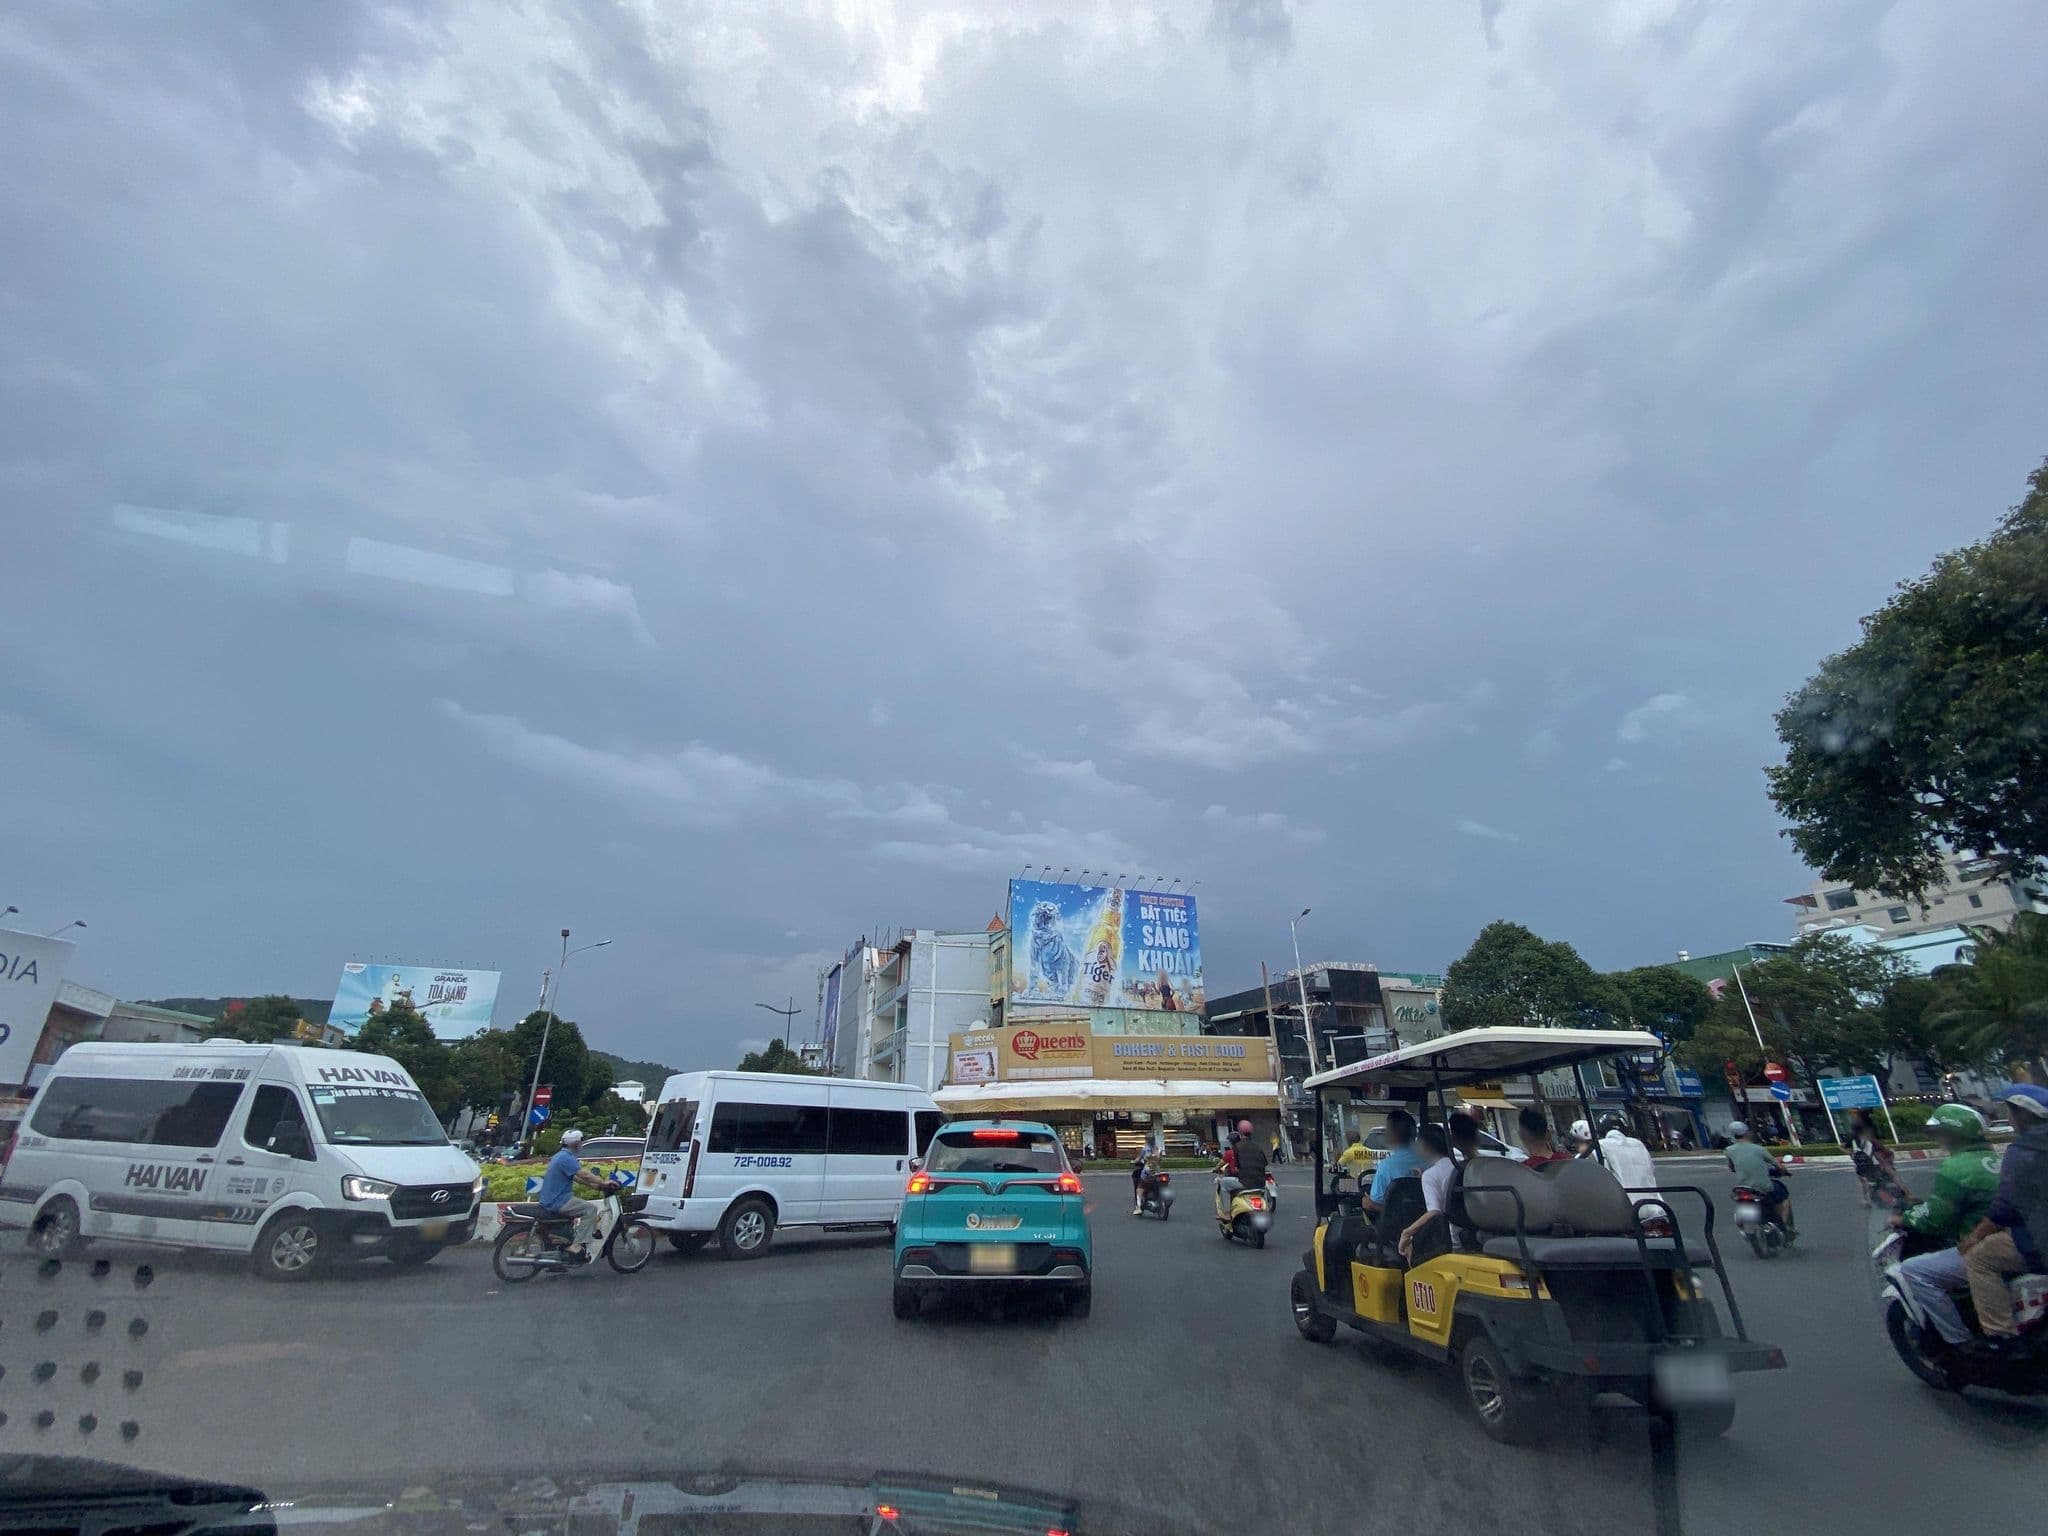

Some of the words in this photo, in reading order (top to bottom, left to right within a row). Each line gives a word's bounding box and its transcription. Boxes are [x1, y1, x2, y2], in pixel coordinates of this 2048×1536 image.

[1140, 905, 1160, 924] BẬT
[1163, 907, 1188, 926] TIỆC
[1142, 921, 1190, 949] SẢNG
[1083, 961, 1115, 984] Tiger
[1138, 948, 1193, 975] KHOÁI
[434, 975, 468, 983] GRANDE
[1113, 1043, 1164, 1057] BAKERY
[1168, 1043, 1176, 1057] &
[1180, 1043, 1210, 1057] FAST
[1214, 1044, 1247, 1057] FOOD
[734, 1156, 792, 1167] 72F-008.92
[1412, 1280, 1436, 1315] CT10
